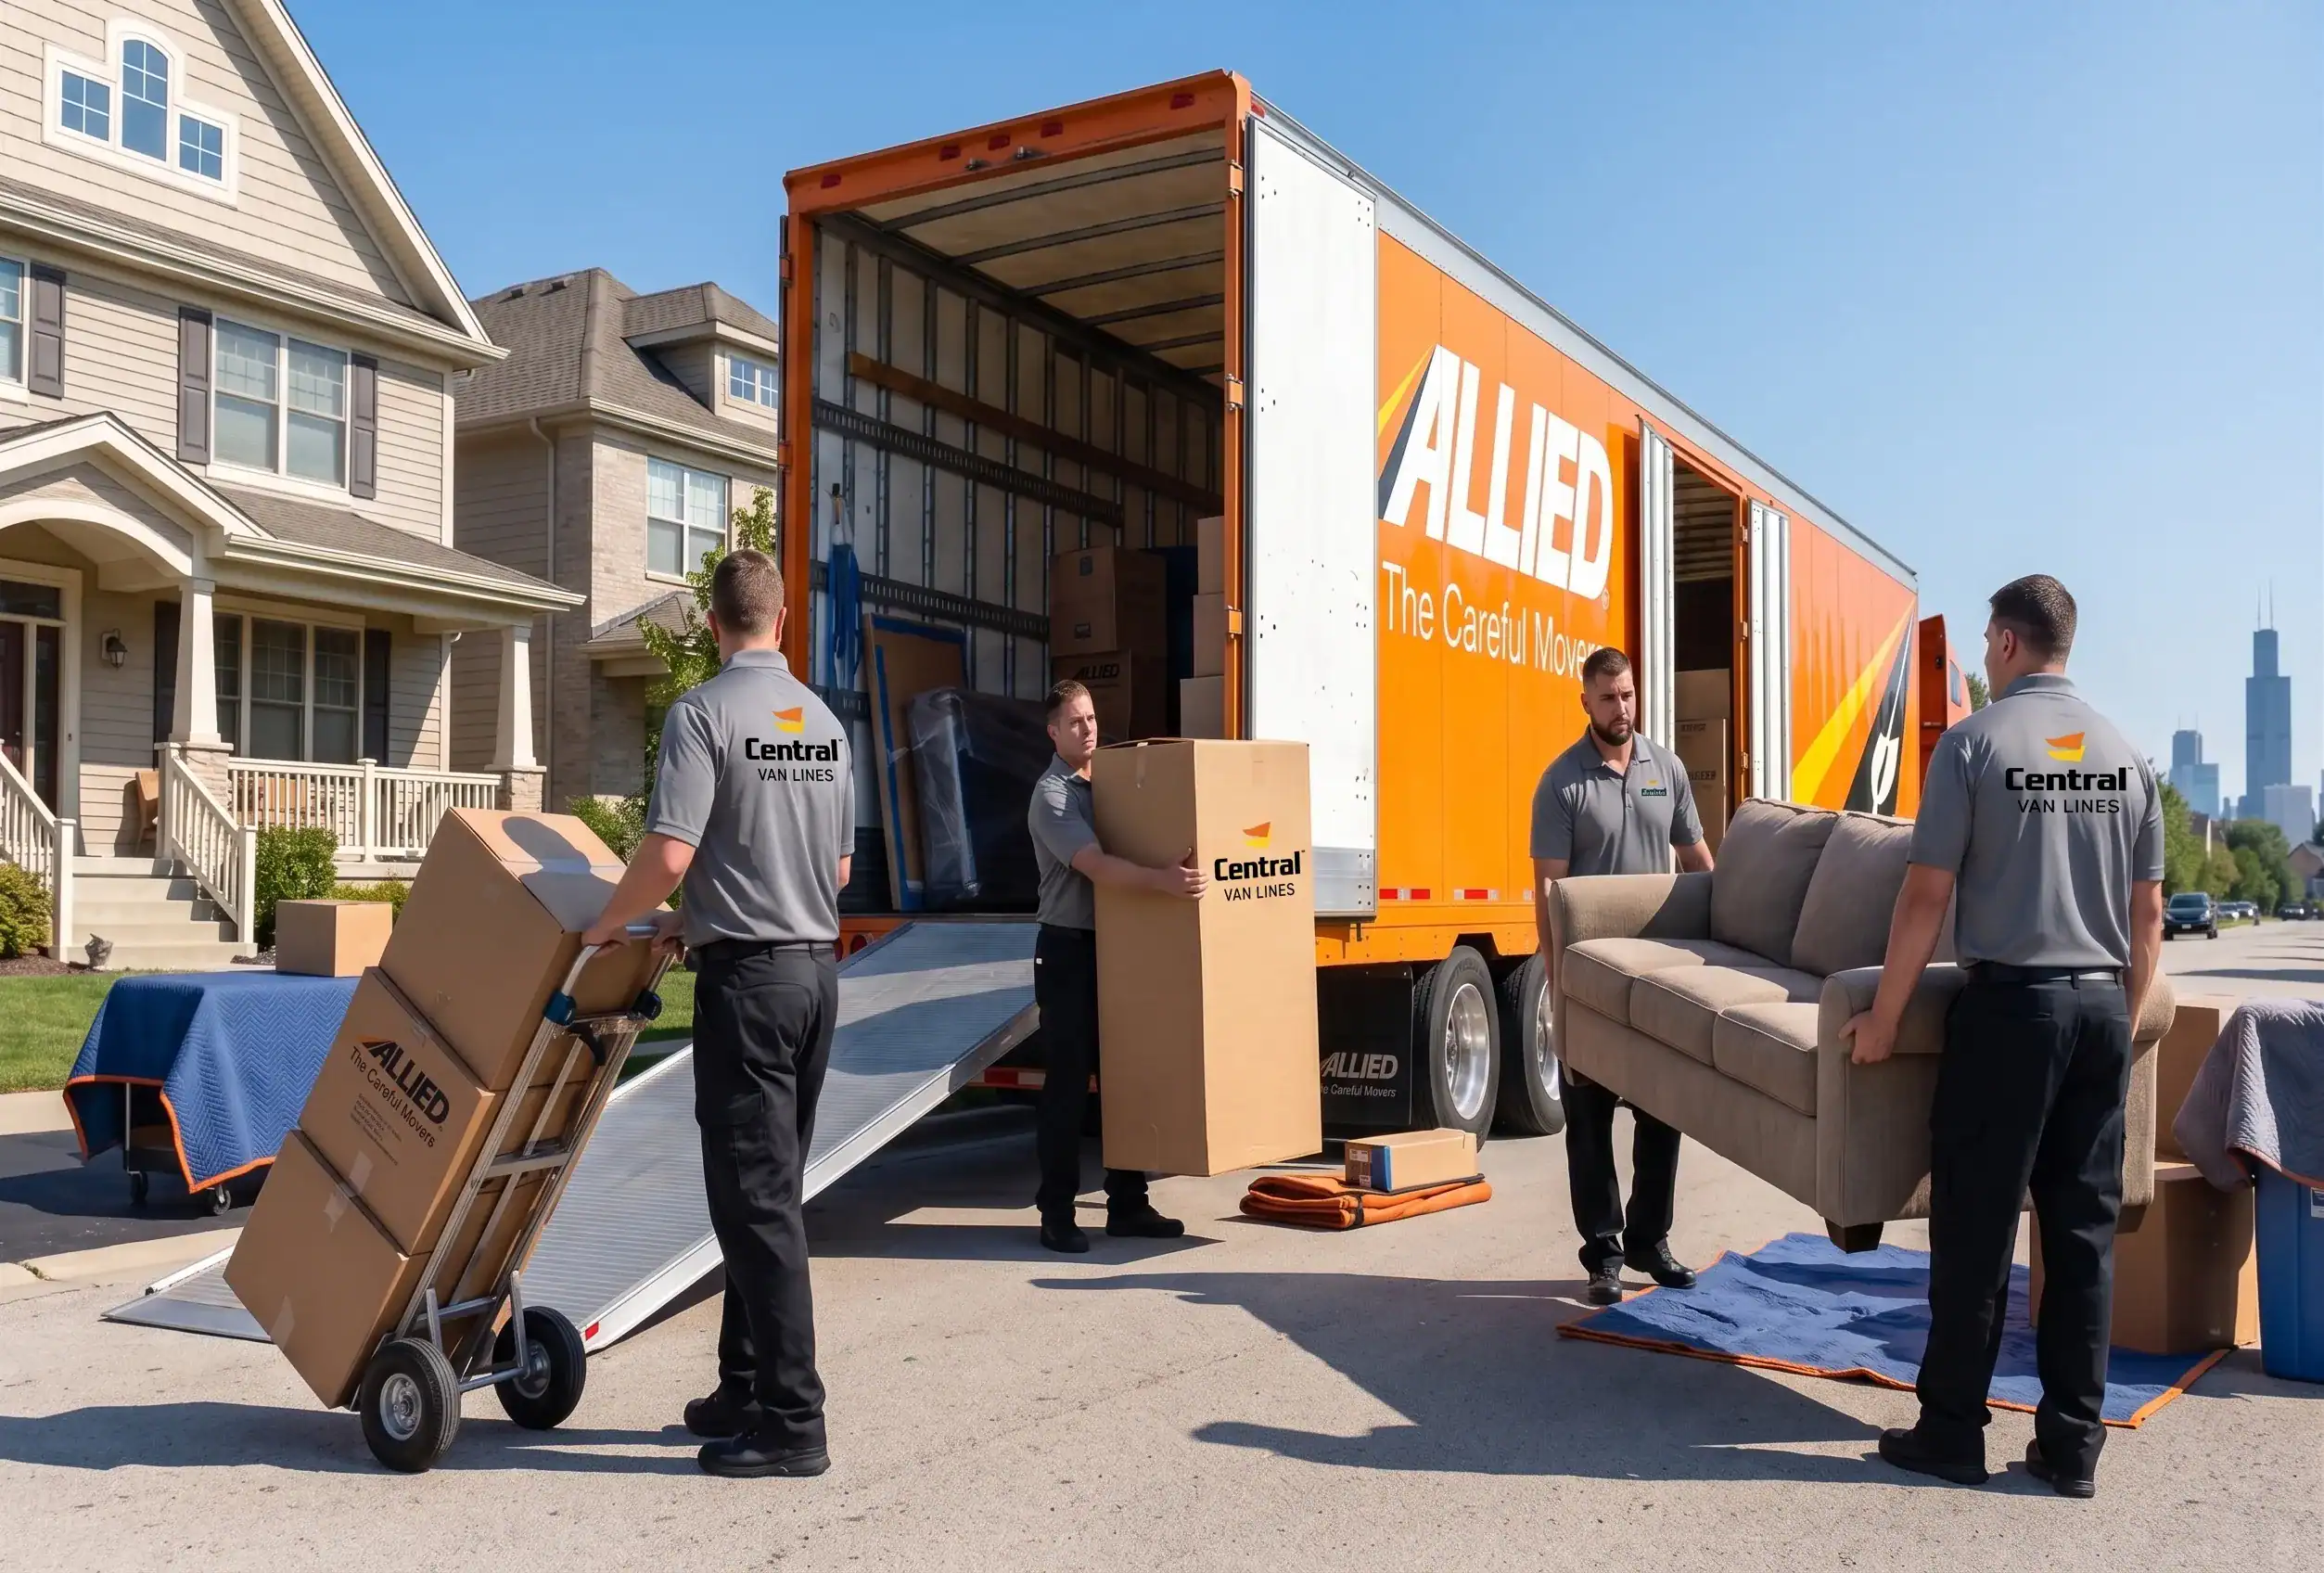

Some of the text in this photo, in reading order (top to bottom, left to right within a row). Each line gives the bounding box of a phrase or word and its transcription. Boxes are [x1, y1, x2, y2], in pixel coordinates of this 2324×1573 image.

[1383, 343, 1614, 600] ALLIED
[1382, 560, 1603, 683] The Careful Mover
[745, 737, 839, 761] Central
[757, 768, 835, 782] VAN LINES
[2005, 767, 2126, 791] Central
[2017, 799, 2120, 813] VAN LINES
[1214, 850, 1301, 882] Central
[1223, 882, 1296, 902] VAN LINES
[1322, 1052, 1398, 1080] ALLIED
[368, 1041, 450, 1125] ALLIED
[1330, 1083, 1363, 1095] Careful
[1364, 1085, 1398, 1097] Movers
[350, 1045, 367, 1073] The
[366, 1068, 403, 1111] Careful
[400, 1104, 437, 1148] Movers
